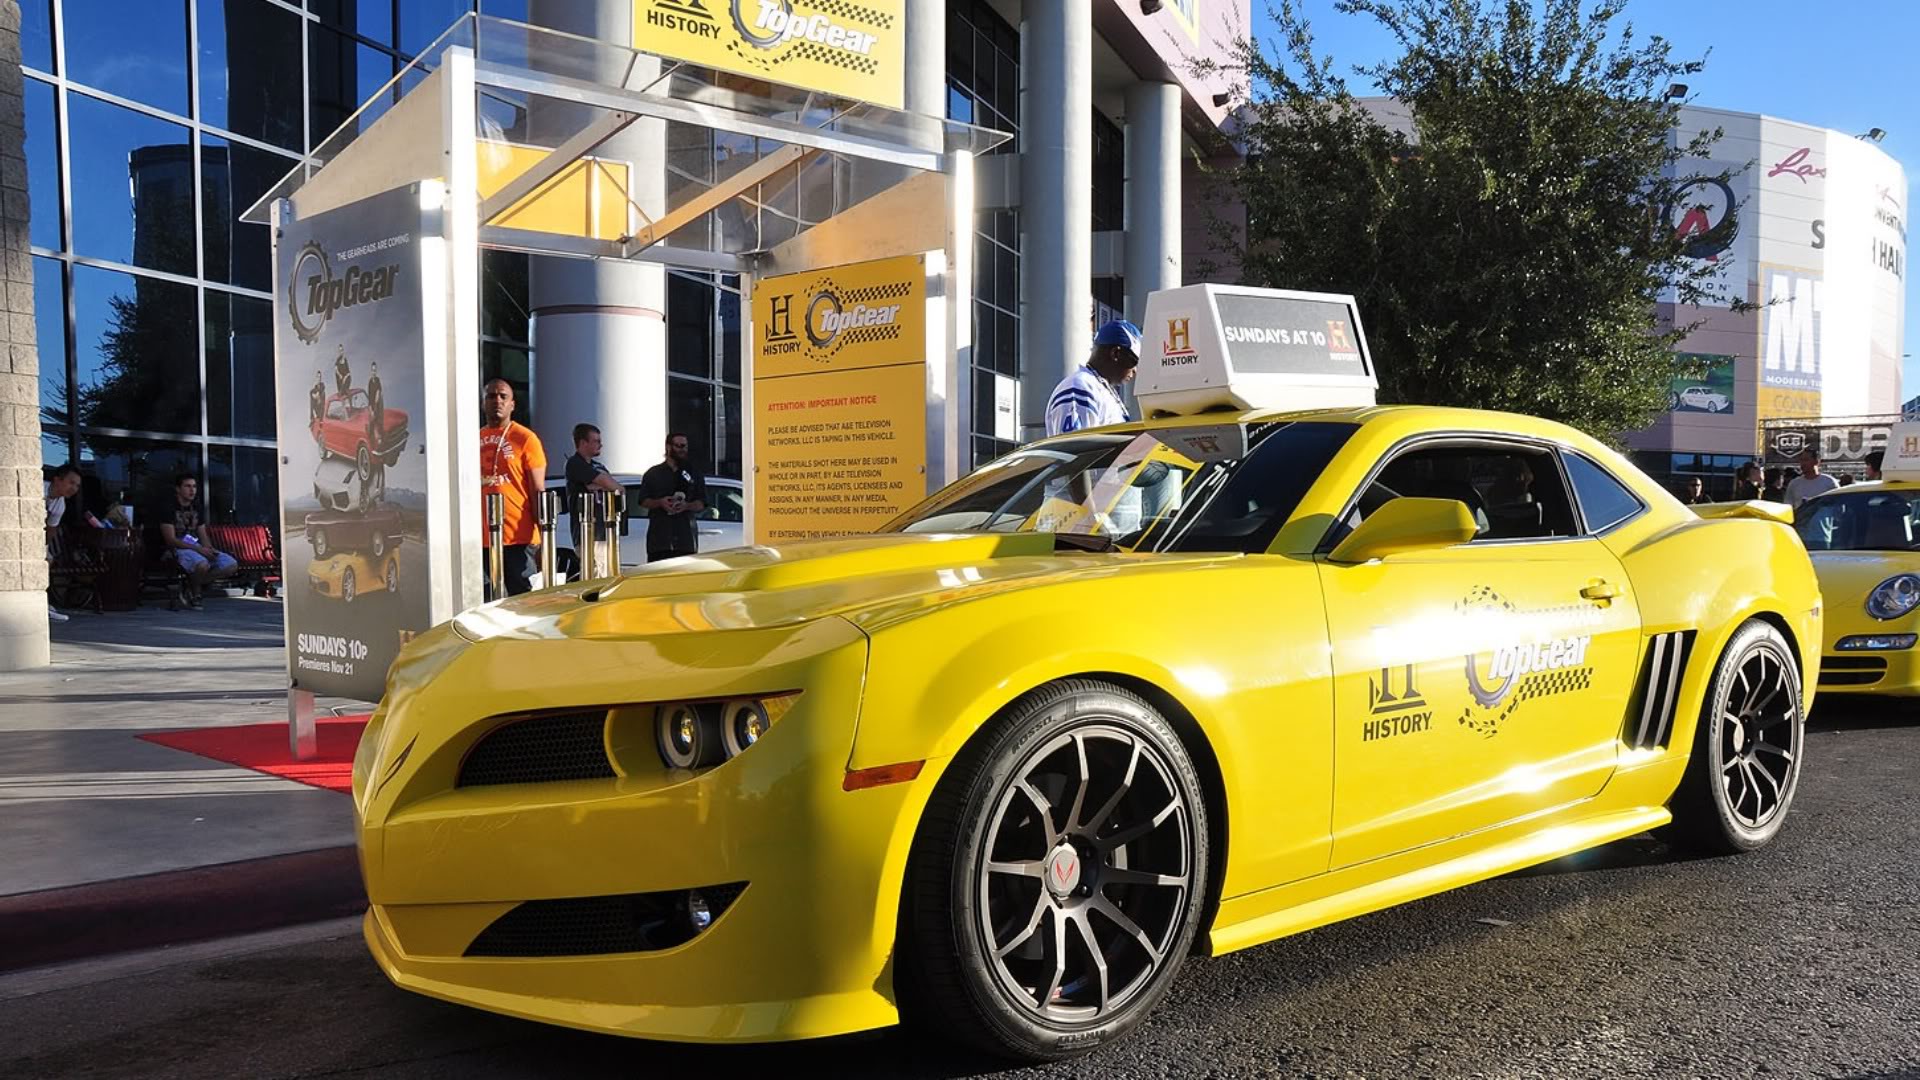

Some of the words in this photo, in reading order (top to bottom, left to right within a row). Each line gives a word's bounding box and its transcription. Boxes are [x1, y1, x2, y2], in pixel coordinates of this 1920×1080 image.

[647, 9, 721, 40] HISTORY
[754, 0, 878, 55] TopGear
[307, 262, 400, 321] TopGear
[820, 303, 900, 336] TopGear
[1225, 326, 1290, 345] SUNDAYS
[1293, 330, 1308, 346] AT
[1310, 331, 1326, 346] 10
[763, 341, 802, 356] HISTORY
[1161, 354, 1199, 366] HISTORY
[768, 401, 806, 412] ATTENTION:
[808, 398, 848, 408] IMPORTANT
[850, 395, 877, 404] NOTICE
[768, 426, 788, 434] PLEASE
[790, 425, 798, 434] BE
[800, 424, 824, 433] ADVISED
[825, 423, 840, 432] THAT
[842, 422, 854, 430] A&E
[855, 420, 891, 430] TELEVISION
[802, 436, 814, 444] LLC
[815, 436, 820, 444] IS
[822, 434, 843, 444] TAPING
[844, 433, 850, 442] IN
[852, 432, 866, 442] THIS
[867, 432, 896, 440] VEHICLE.
[768, 461, 780, 469] THE
[780, 460, 812, 468] MATERIALS
[813, 459, 829, 468] SHOT
[830, 458, 846, 467] HERE
[848, 458, 861, 466] MAY
[862, 457, 872, 466] BE
[872, 456, 890, 465] USED
[891, 456, 898, 464] IN
[768, 472, 788, 480] WHOLE
[789, 472, 798, 480] OR
[799, 472, 806, 480] IN
[824, 470, 832, 479] BY
[833, 470, 846, 478] A&E
[846, 469, 882, 478] TELEVISION
[816, 482, 826, 490] ITS
[854, 481, 888, 490] LICENSEES
[888, 481, 903, 490] AND
[802, 494, 814, 502] ANY
[844, 494, 850, 502] IN
[852, 494, 864, 502] ANY
[866, 494, 888, 502] MEDIA,
[768, 507, 808, 515] THROUGHOUT
[809, 506, 820, 514] THE
[822, 506, 851, 514] UNIVERSE
[852, 506, 860, 514] IN
[768, 530, 776, 538] BY
[778, 530, 806, 538] ENTERING
[807, 530, 821, 538] THIS
[298, 633, 347, 658] SUNDAYS
[348, 640, 368, 660] 10P
[298, 656, 330, 672] Premieres
[332, 661, 344, 674] Nov
[344, 662, 354, 675] 21
[1363, 711, 1433, 742] HISTORY
